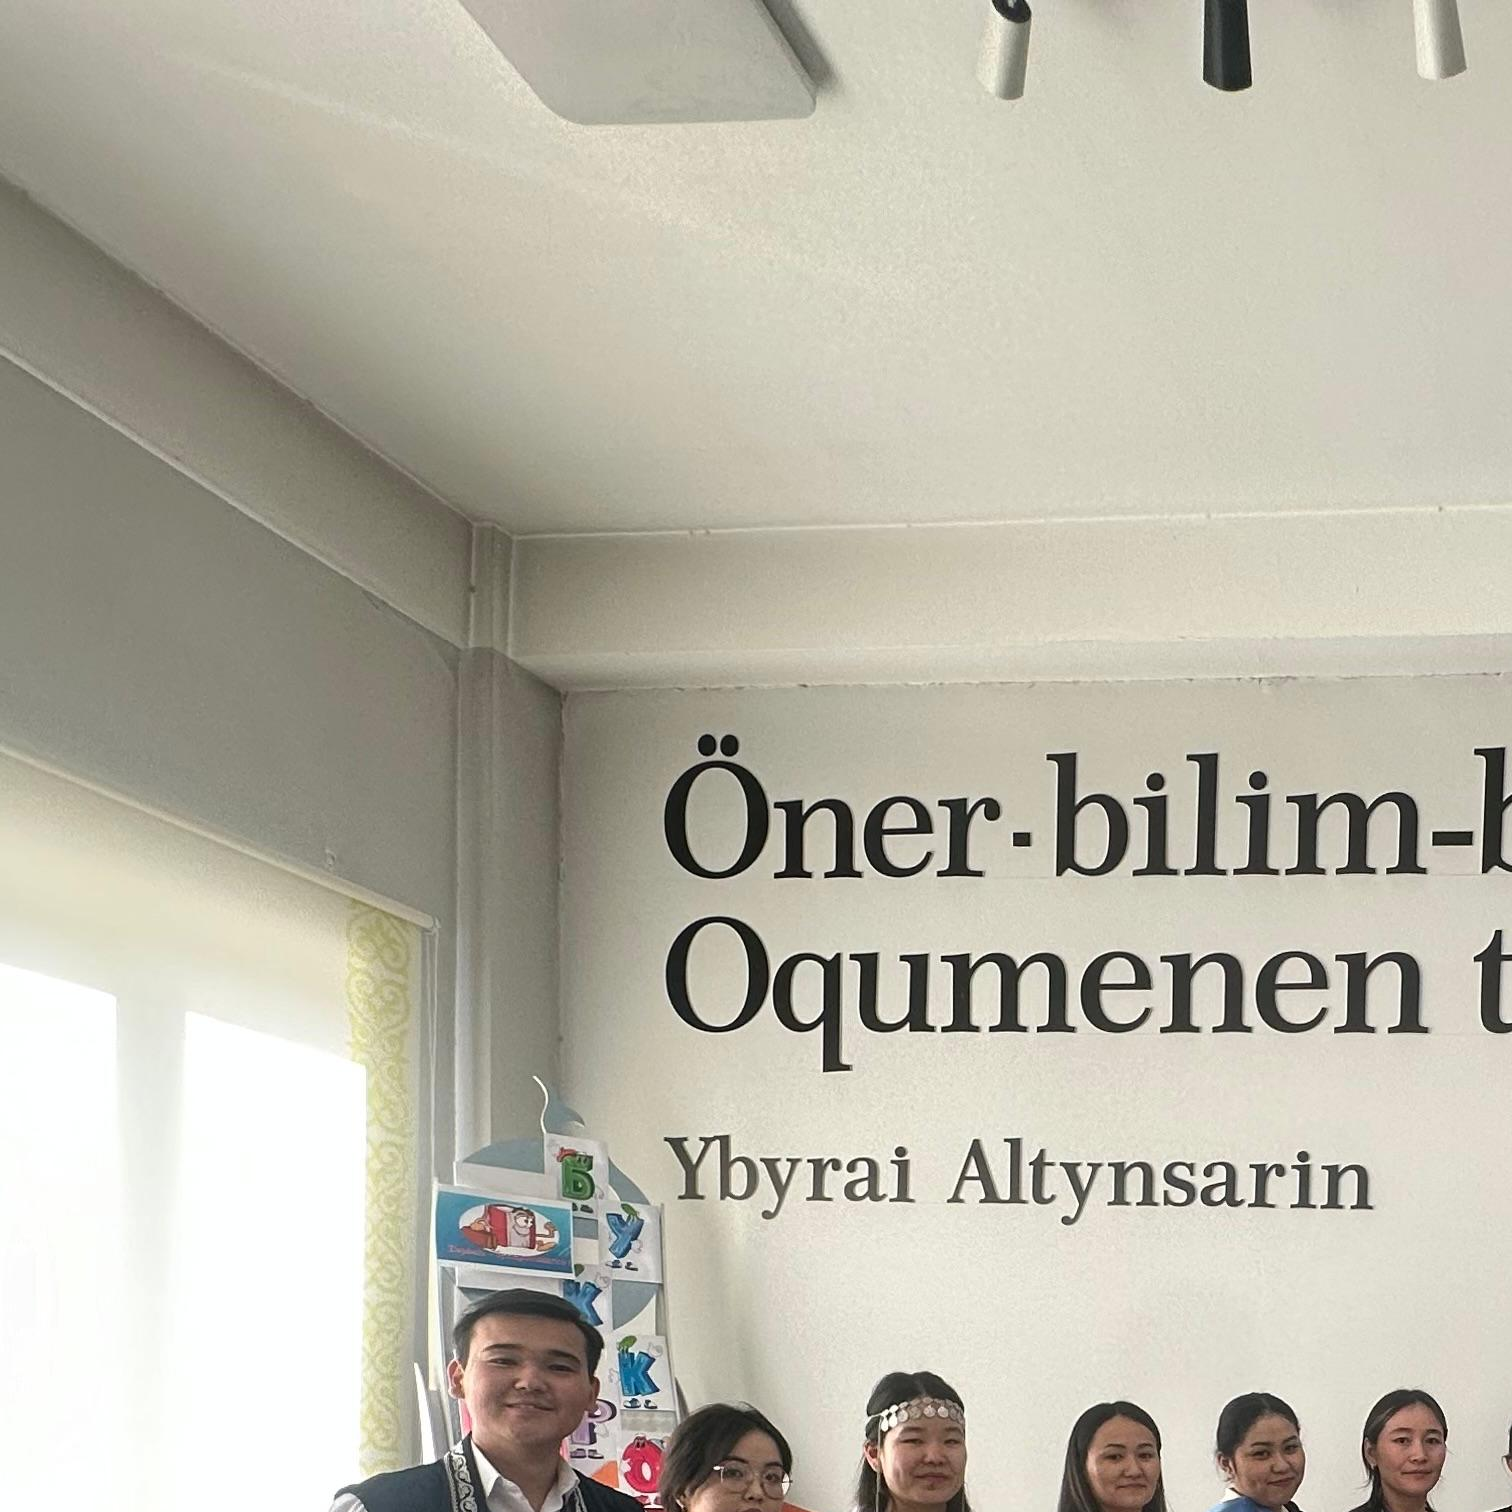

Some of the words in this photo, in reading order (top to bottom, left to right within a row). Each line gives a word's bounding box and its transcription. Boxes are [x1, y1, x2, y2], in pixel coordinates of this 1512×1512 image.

[665, 916, 1429, 1072] Oqumenen
[663, 1134, 915, 1220] Ybyrai
[947, 1137, 1374, 1225] Altynsarin
